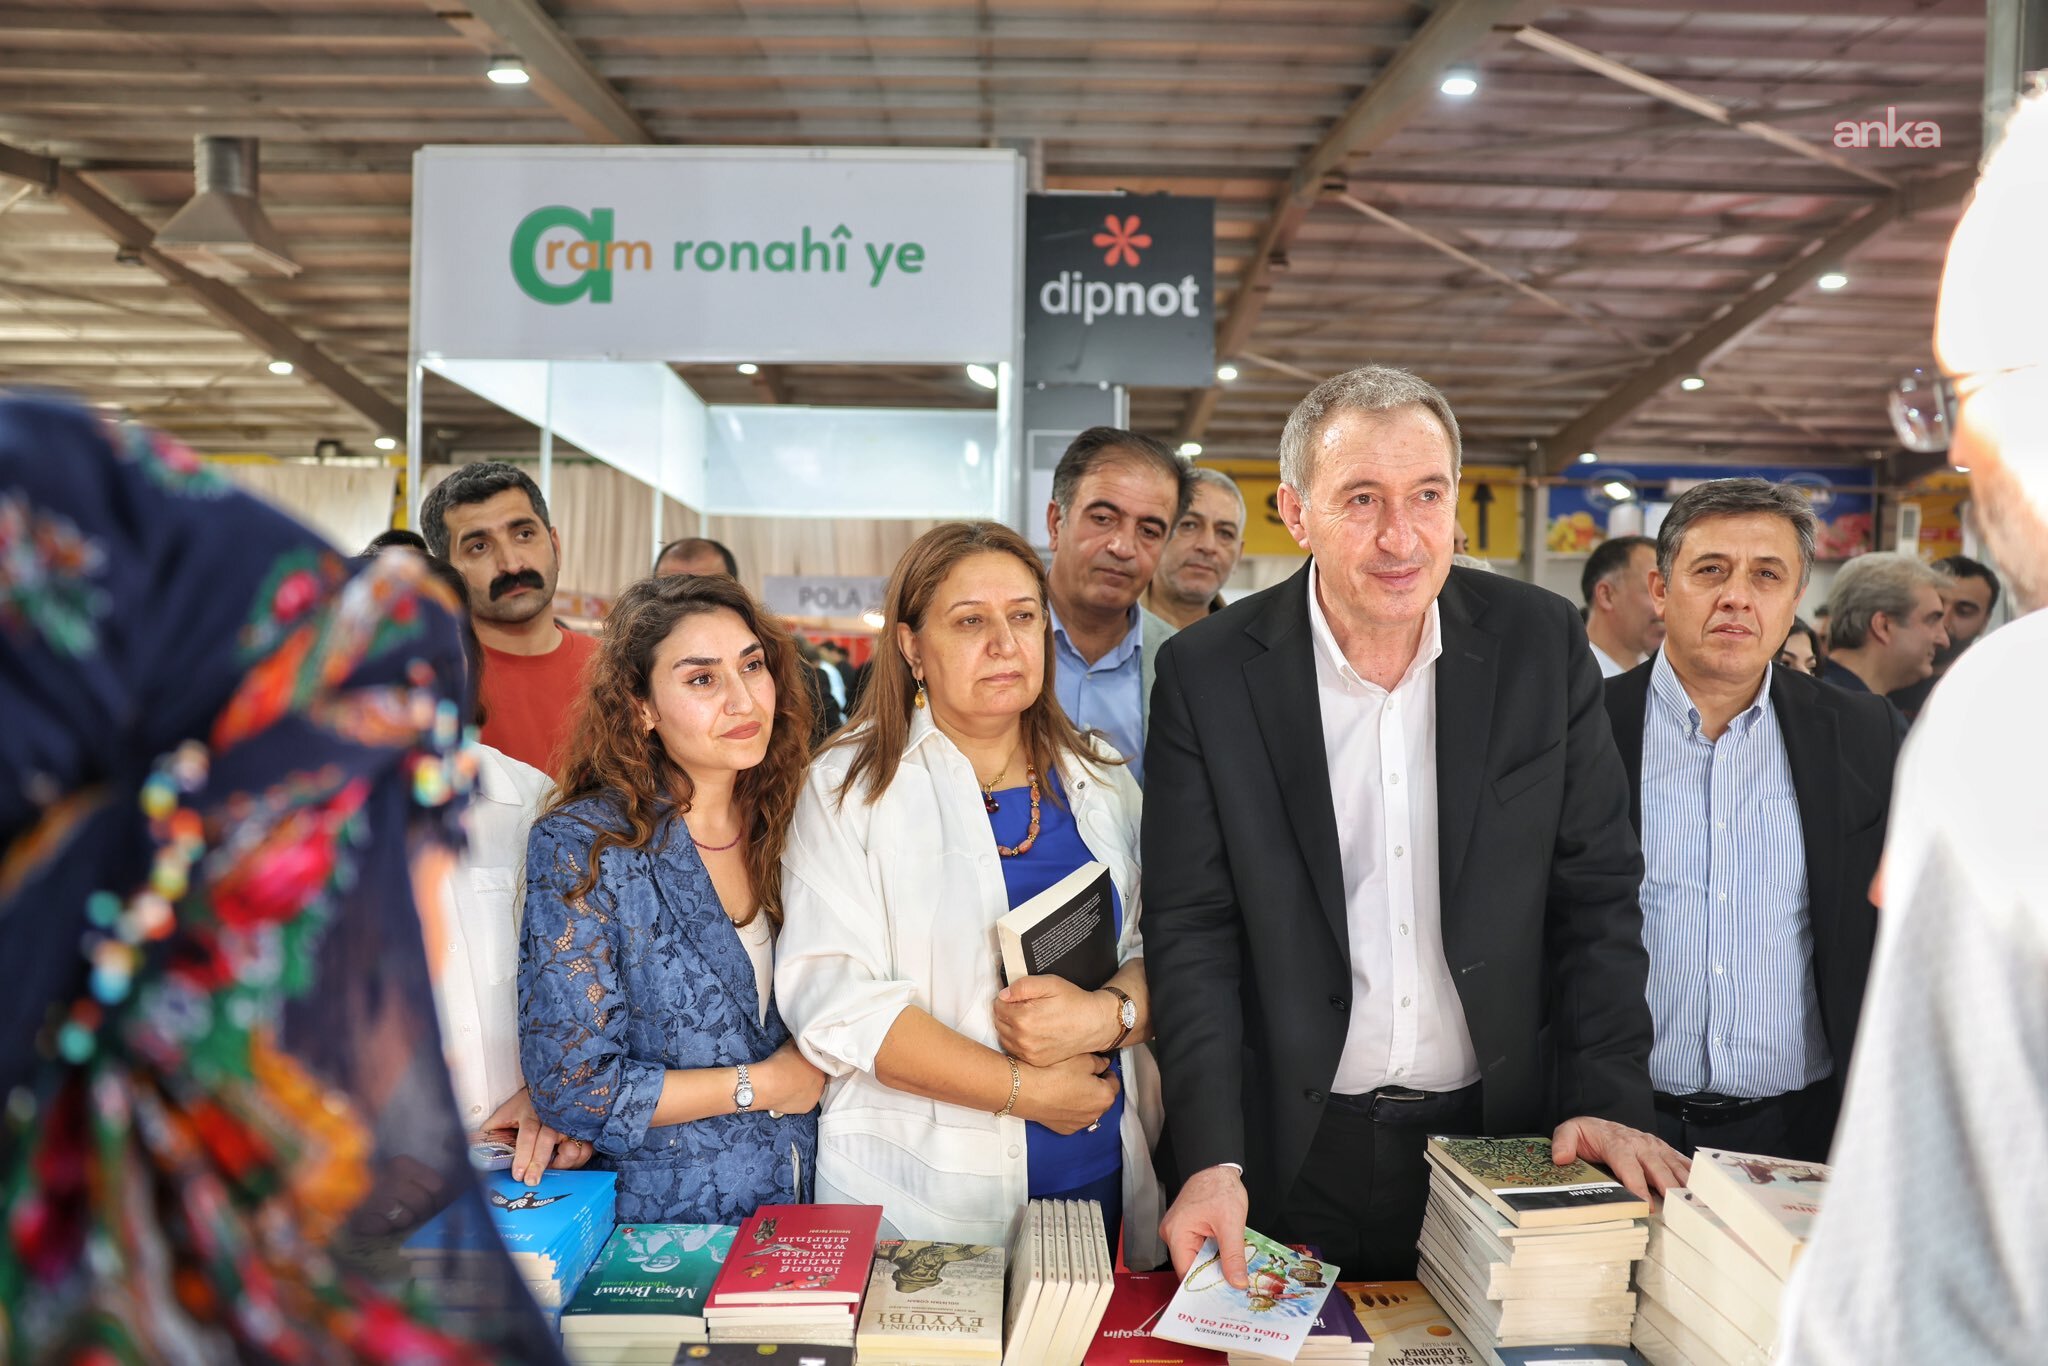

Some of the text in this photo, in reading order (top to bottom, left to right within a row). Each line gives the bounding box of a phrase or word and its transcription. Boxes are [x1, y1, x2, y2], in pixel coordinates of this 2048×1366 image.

[673, 224, 853, 272] ronahî
[865, 242, 926, 288] ye
[1039, 270, 1200, 325] dipnot
[798, 586, 862, 610] POLA
[1194, 1327, 1241, 1339] ANDERSEN
[1219, 1322, 1250, 1333] Qral
